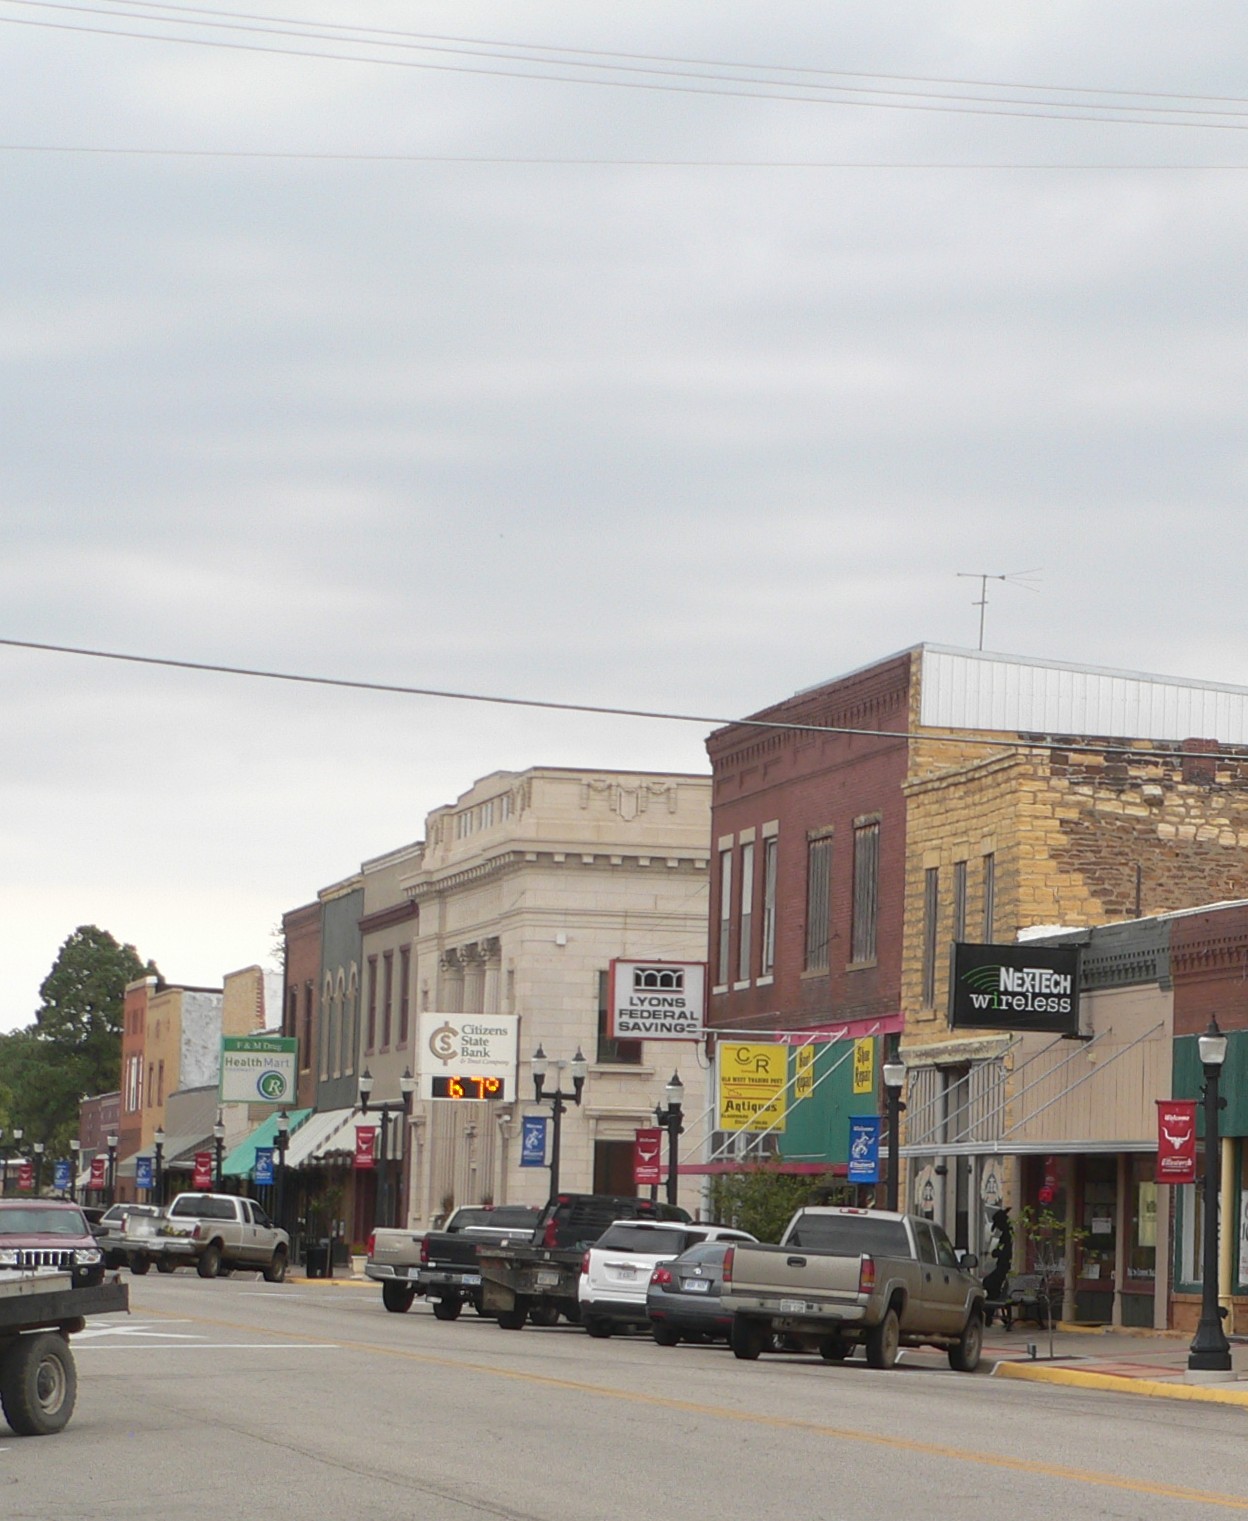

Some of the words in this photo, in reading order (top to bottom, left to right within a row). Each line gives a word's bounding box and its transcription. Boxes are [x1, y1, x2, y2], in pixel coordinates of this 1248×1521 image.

[629, 996, 687, 1008] LYONS
[969, 991, 1072, 1013] wireless
[618, 1008, 700, 1021] FEDERAL
[461, 1024, 508, 1036] Citizens
[618, 1021, 698, 1034] SAVINGS
[461, 1035, 490, 1047] State
[461, 1046, 491, 1058] Bank
[736, 1046, 751, 1062] C
[225, 1057, 263, 1068] Health
[263, 1057, 290, 1068] Mart
[755, 1059, 769, 1073] R
